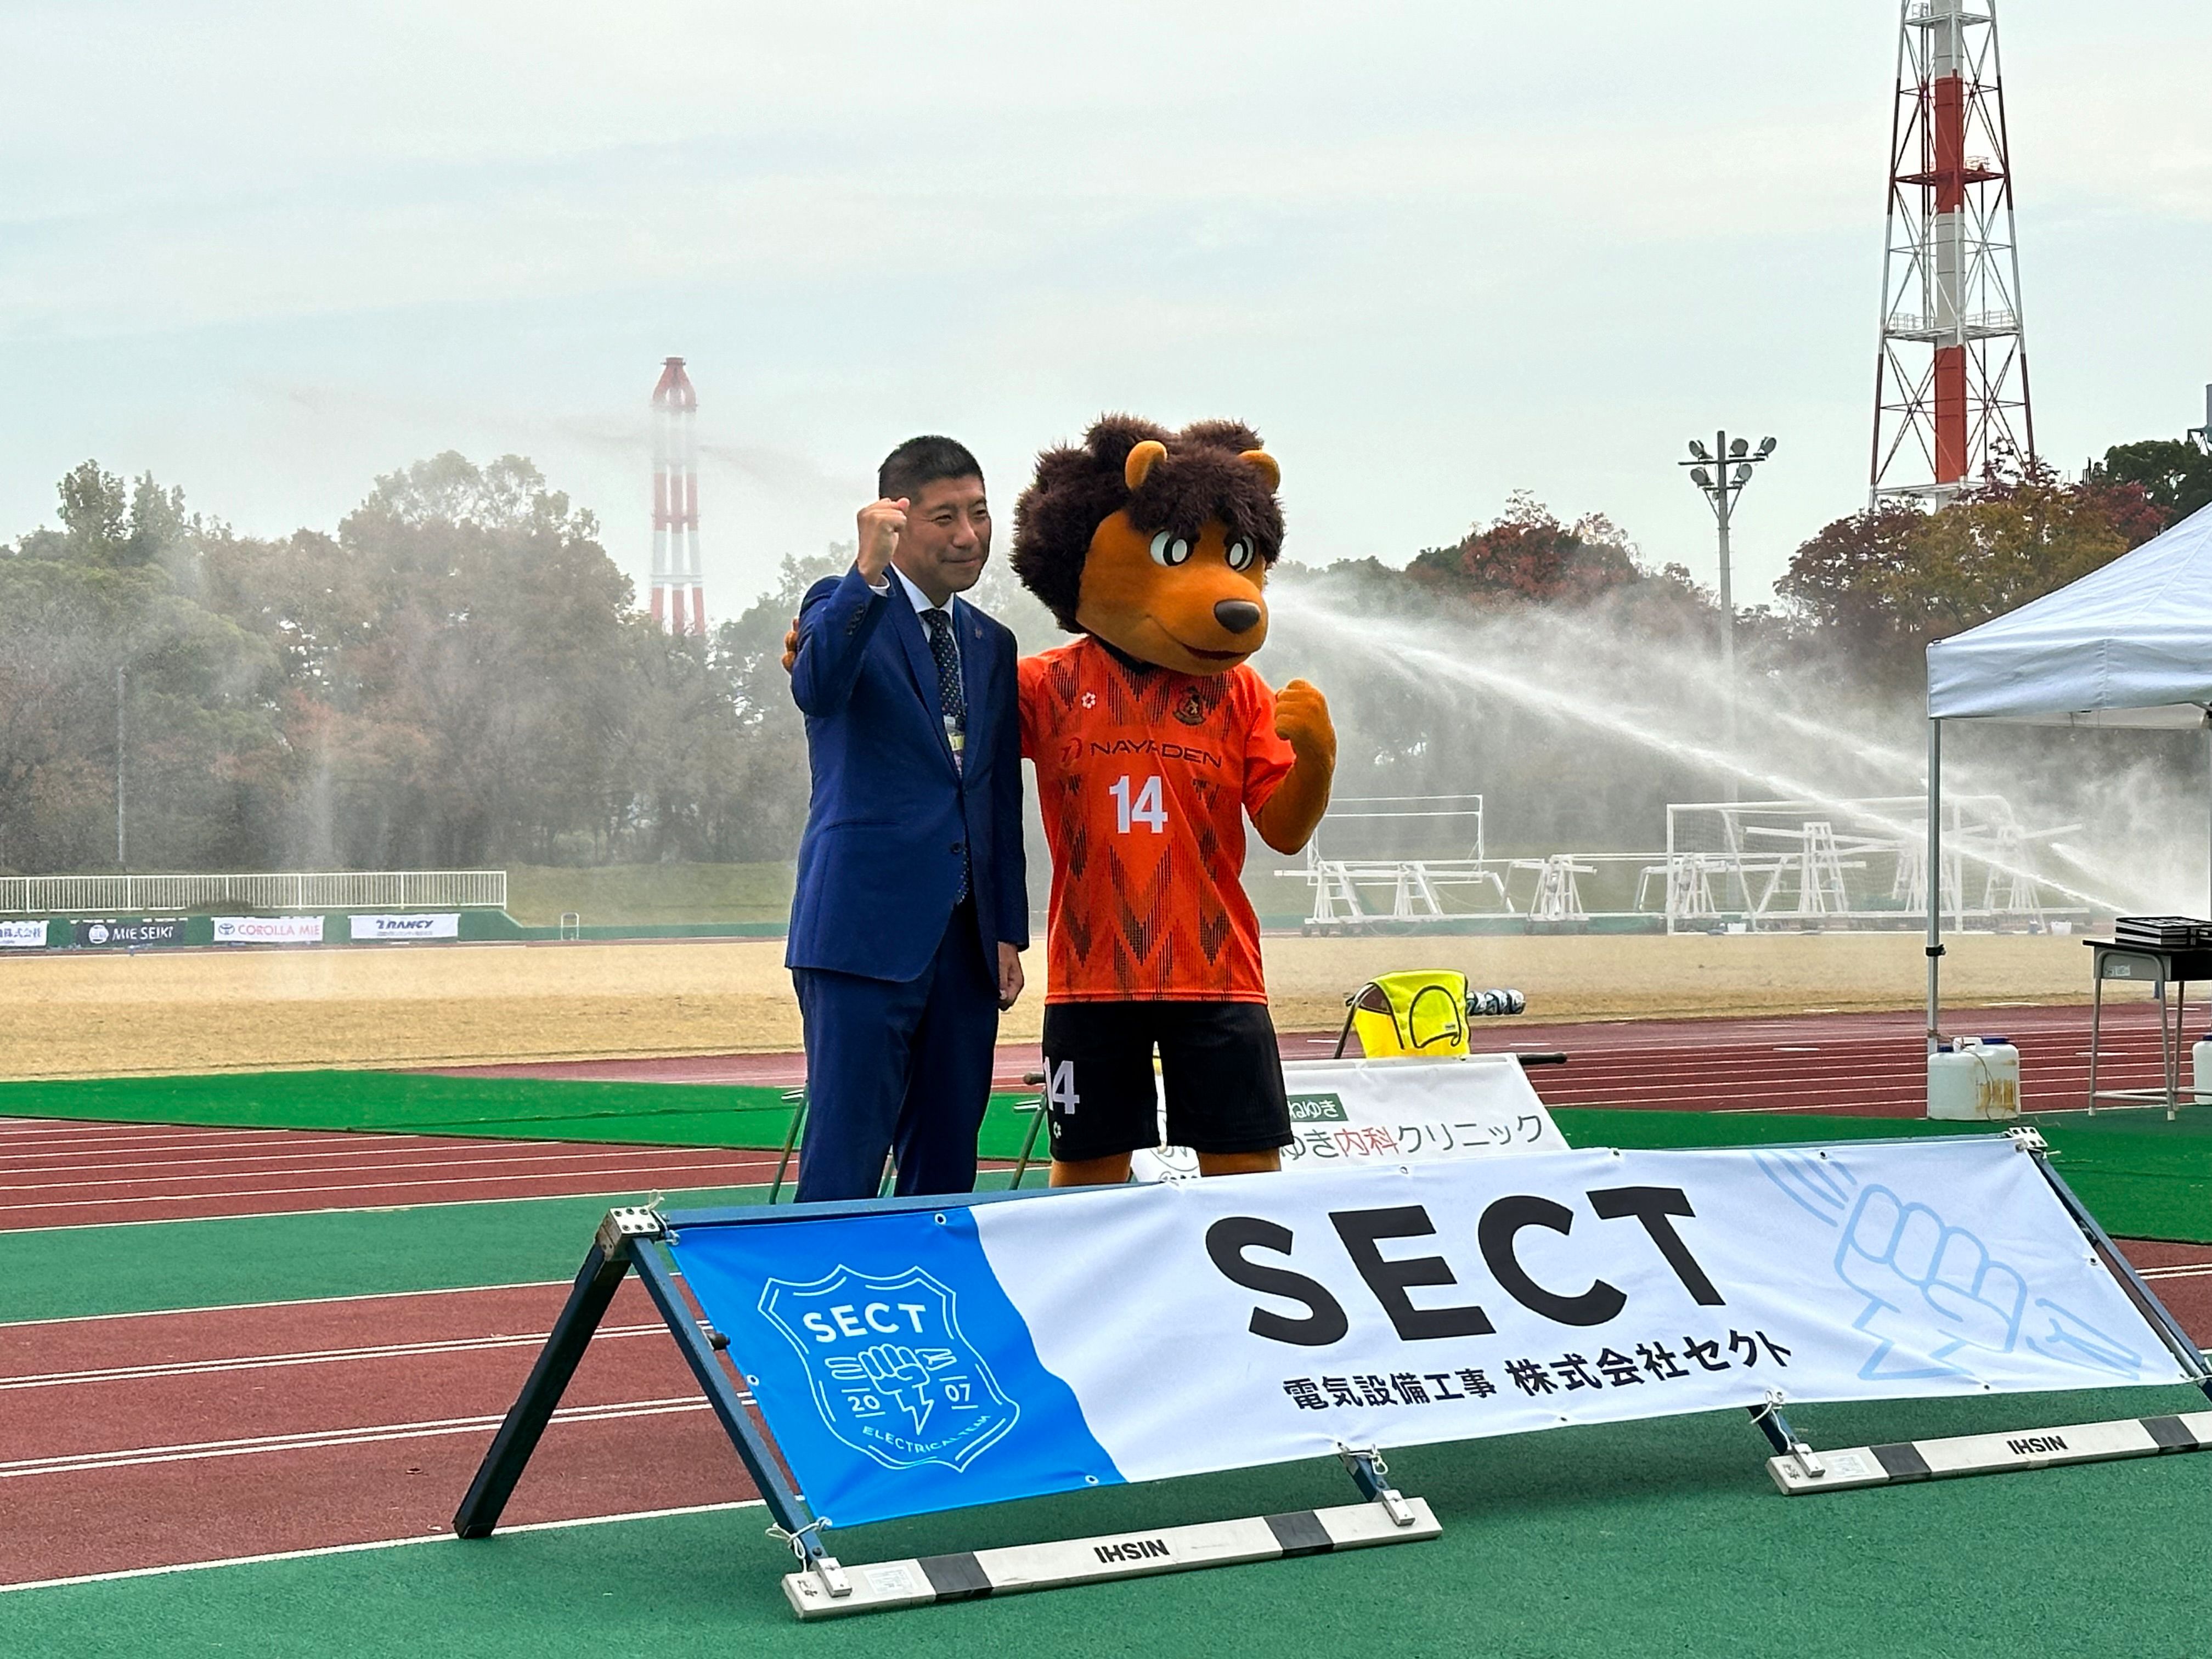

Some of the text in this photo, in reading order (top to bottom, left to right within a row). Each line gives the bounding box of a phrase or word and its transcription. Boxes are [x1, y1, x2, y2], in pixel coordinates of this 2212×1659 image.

[1109, 775, 1169, 834] 14
[112, 926, 173, 941] MIE SEIKI
[238, 924, 320, 936] COROLLA MIE
[1043, 1056, 1080, 1115] 14
[1206, 1186, 1726, 1347] SECT
[803, 1302, 927, 1342] SECT
[1283, 1329, 1792, 1410] 電気設備工事 株式会社セクト
[848, 1383, 971, 1412] 20 07
[862, 1425, 963, 1453] ELECTRICAL
[2006, 1435, 2069, 1455] IHSIN
[1093, 1539, 1170, 1564] IHSIN
